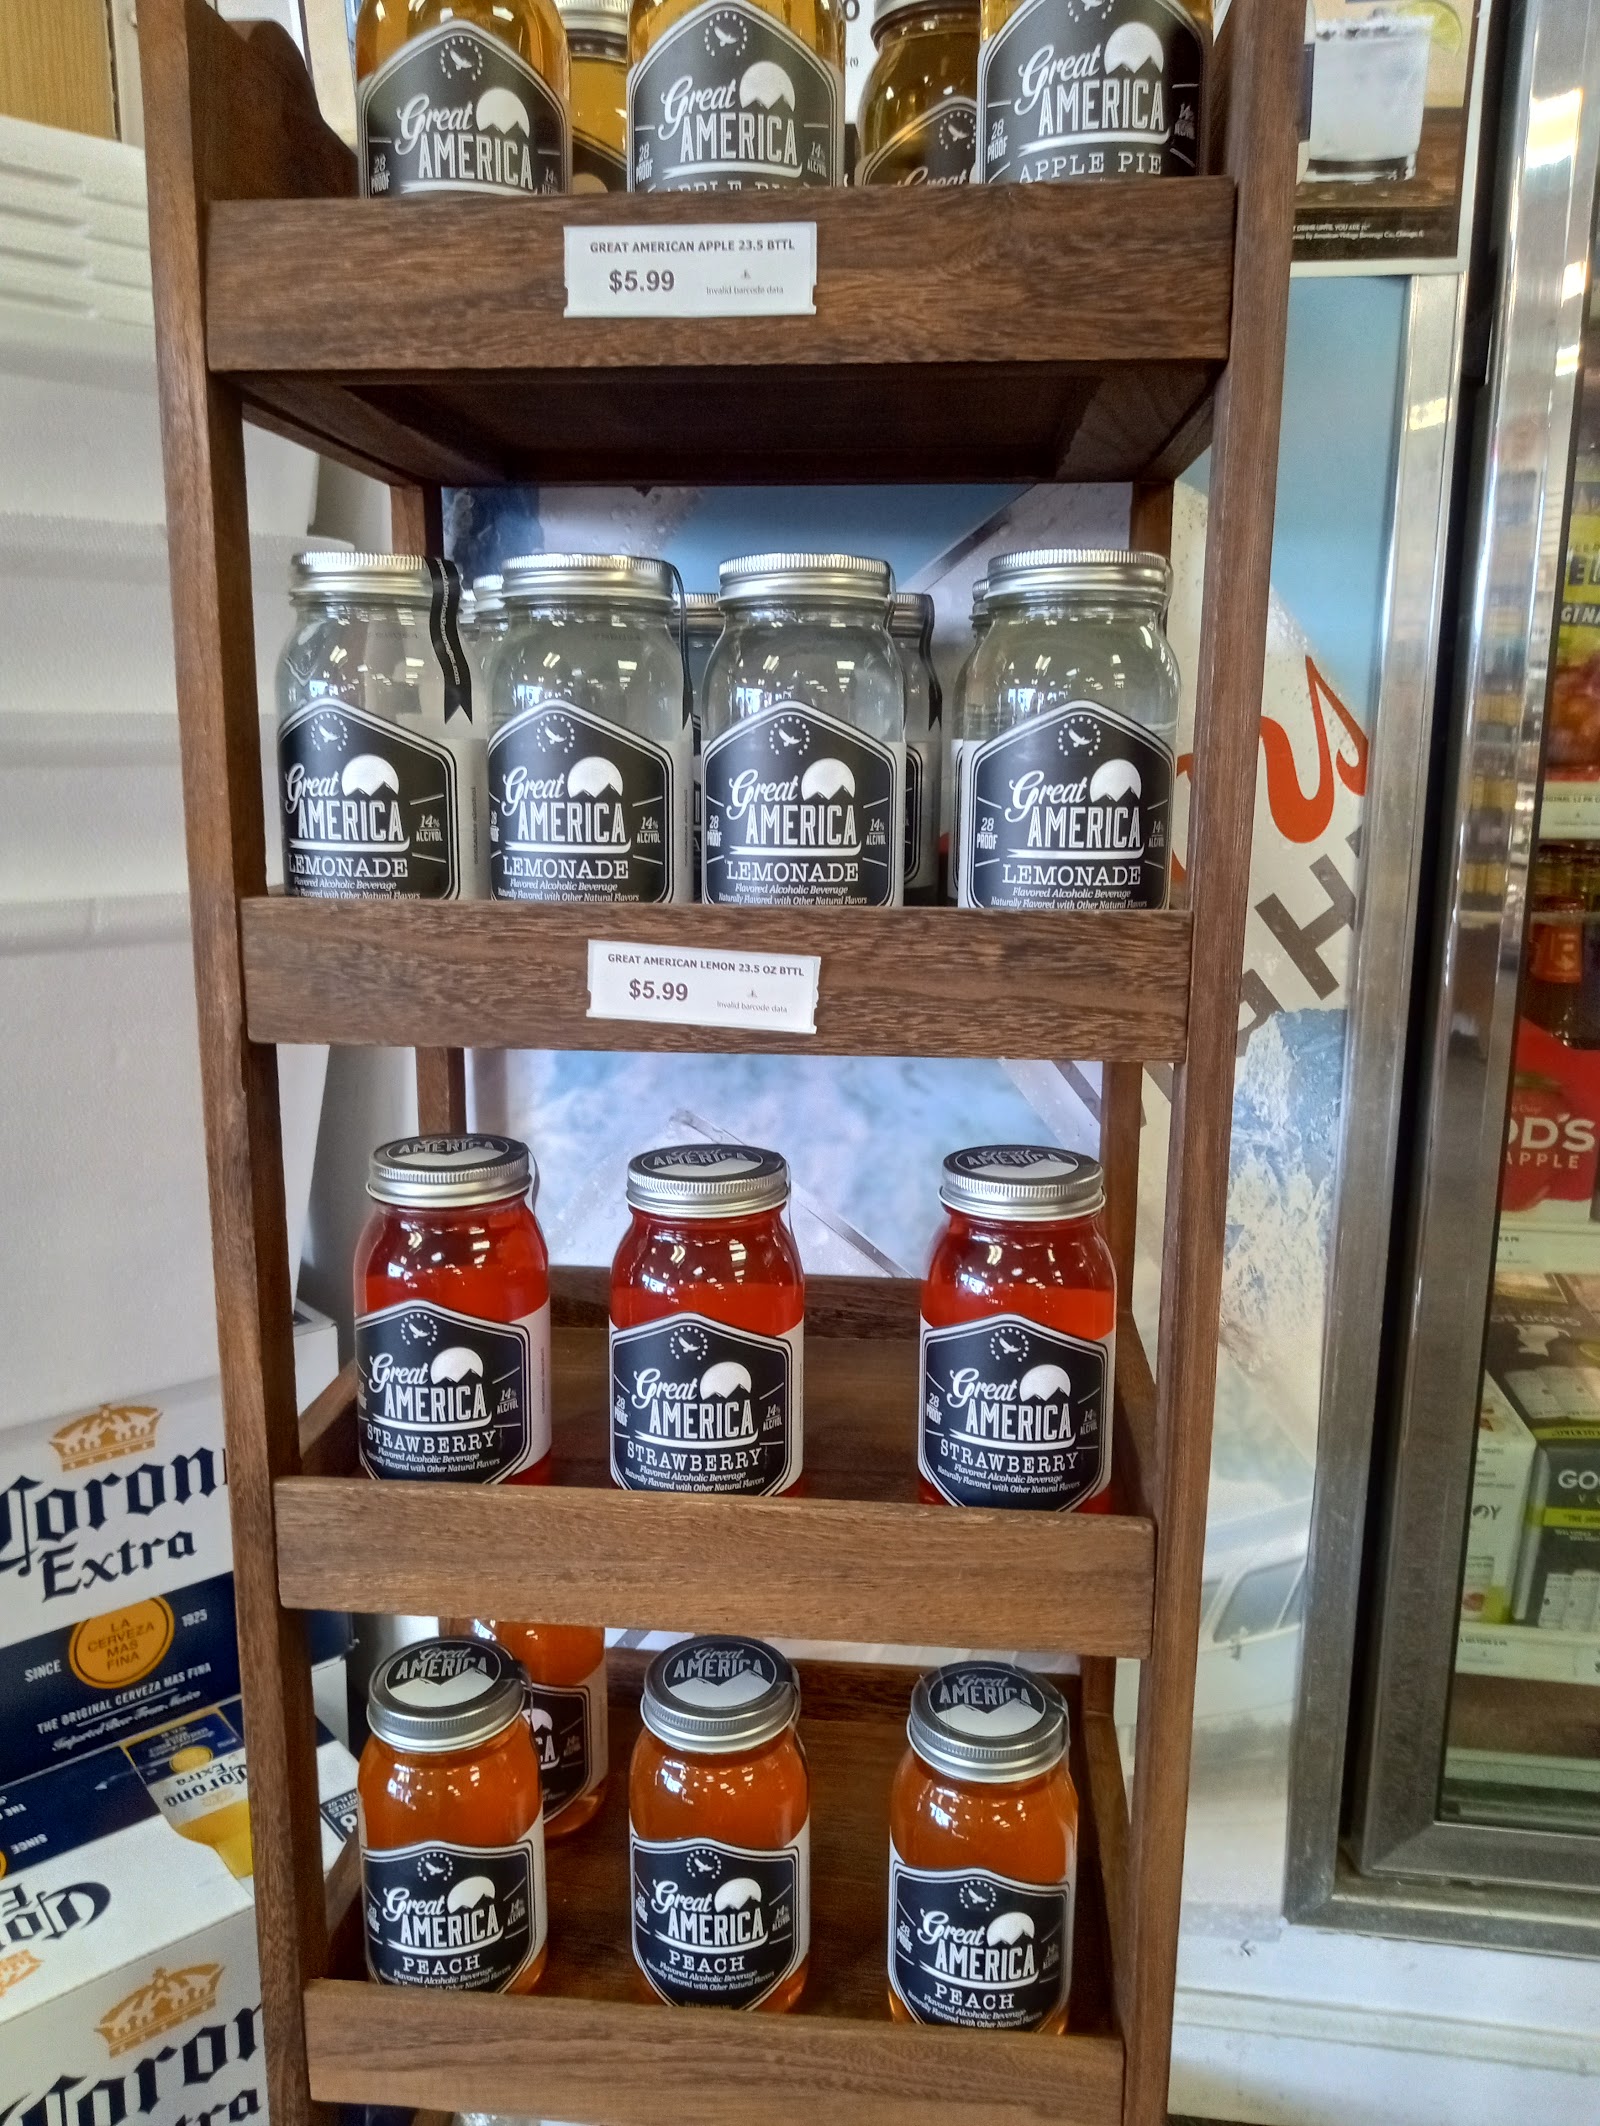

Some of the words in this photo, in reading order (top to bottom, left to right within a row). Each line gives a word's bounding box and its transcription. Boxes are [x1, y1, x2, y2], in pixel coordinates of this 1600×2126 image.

[1014, 44, 1101, 115] Great
[658, 75, 736, 140] Great
[1038, 77, 1164, 137] AMERICA
[395, 93, 473, 155] Great
[991, 119, 1004, 140] 28
[680, 112, 797, 165] AMERICA
[987, 137, 1009, 163] PROOF
[419, 133, 533, 190] AMERICA
[639, 142, 649, 161] 28
[636, 158, 653, 183] PROOF
[1020, 152, 1104, 183] APPLE
[1118, 150, 1162, 175] PIE
[590, 241, 628, 253] GREAT
[632, 241, 694, 252] AMERICAN
[698, 240, 735, 251] APPLE
[739, 239, 763, 250] 23.5
[767, 239, 795, 250] BTTL
[609, 269, 675, 294] $5.99
[706, 286, 731, 295] Invalid
[767, 285, 784, 294] data
[285, 763, 339, 814] Great
[501, 765, 564, 817] Great
[726, 769, 798, 820] Great
[1004, 770, 1087, 823] Great
[298, 799, 404, 842] AMERICA
[518, 801, 626, 843] AMERICA
[709, 816, 719, 828] 28
[745, 804, 857, 846] AMERICA
[981, 817, 994, 831] 28
[1027, 807, 1141, 848] AMERICA
[707, 831, 722, 847] PROOF
[977, 833, 998, 850] PROOF
[289, 853, 408, 878] LEMONADE
[503, 855, 629, 879] LEMONADE
[726, 862, 858, 882] LEMONADE
[1002, 864, 1141, 886] LEMONADE
[319, 879, 355, 889] Alcoholic
[357, 881, 397, 891] Beverage
[510, 878, 538, 889] Flavored
[539, 880, 577, 891] Alcoholic
[578, 882, 618, 892] Beverage
[544, 891, 561, 901] with
[562, 892, 583, 901] Other
[584, 893, 613, 902] Natural
[735, 884, 768, 893] Flavored
[769, 885, 808, 894] Alcoholic
[810, 886, 848, 896] Beverage
[1012, 887, 1050, 897] Flavored
[1052, 888, 1093, 898] Alcoholic
[1094, 889, 1131, 899] Beverage
[744, 894, 773, 904] Flavored
[774, 896, 791, 905] with
[793, 896, 813, 905] Other
[814, 896, 843, 905] Natural
[991, 896, 1022, 908] Naturally
[1023, 898, 1055, 908] Flavored
[1057, 899, 1075, 909] with
[1076, 900, 1098, 909] Other
[608, 953, 641, 964] GREAT
[643, 957, 697, 968] AMERICAN
[700, 961, 735, 971] LEMON
[738, 963, 760, 973] 23.5
[763, 965, 776, 975] OZ
[779, 966, 804, 976] BTTL
[629, 978, 688, 1001] $5.99
[717, 1000, 740, 1010] Invalid
[741, 1002, 770, 1012] barcode
[771, 1004, 787, 1013] data
[368, 1353, 428, 1393] Great
[631, 1368, 697, 1409] Great
[929, 1392, 939, 1406] 28
[947, 1368, 1017, 1409] Great
[384, 1384, 487, 1422] AMERICA
[616, 1395, 626, 1409] 28
[649, 1399, 754, 1440] AMERICA
[964, 1399, 1072, 1442] AMERICA
[367, 1422, 496, 1455] STRAWBERRY
[406, 1454, 439, 1464] Alcoholic
[440, 1452, 480, 1463] Beverage
[627, 1439, 762, 1473] STRAWBERRY
[940, 1438, 1078, 1474] STRAWBERRY
[640, 1464, 670, 1480] Flavored
[671, 1471, 707, 1482] Alcoholic
[709, 1471, 746, 1482] Beverage
[954, 1463, 986, 1480] Flavored
[987, 1471, 1026, 1483] Alcoholic
[1027, 1474, 1063, 1485] Beverage
[38, 1530, 198, 1603] Extra
[87, 1621, 154, 1654] CERVEZA
[110, 1617, 130, 1633] LA
[106, 1641, 139, 1659] MAS
[106, 1653, 139, 1671] FINA
[24, 1658, 61, 1683] SINCE
[396, 1656, 488, 1680] AMERICA
[673, 1658, 764, 1680] AMERICA
[37, 1717, 59, 1734] THE
[61, 1698, 112, 1726] ORIGINAL
[115, 1682, 162, 1706] CERVEZA
[164, 1673, 185, 1687] MAS
[187, 1662, 212, 1679] FINA
[939, 1684, 1031, 1706] AMERICA
[11, 1833, 48, 1855] SINCE
[382, 1886, 445, 1922] Great
[651, 1878, 712, 1912] Great
[399, 1904, 501, 1948] AMERICA
[667, 1908, 765, 1947] AMERICA
[917, 1907, 986, 1946] Great
[402, 1954, 480, 1976] PEACH
[669, 1949, 745, 1975] PEACH
[935, 1944, 1035, 1981] AMERICA
[934, 1982, 1015, 2010] PEACH
[955, 2006, 991, 2019] Alcoholic
